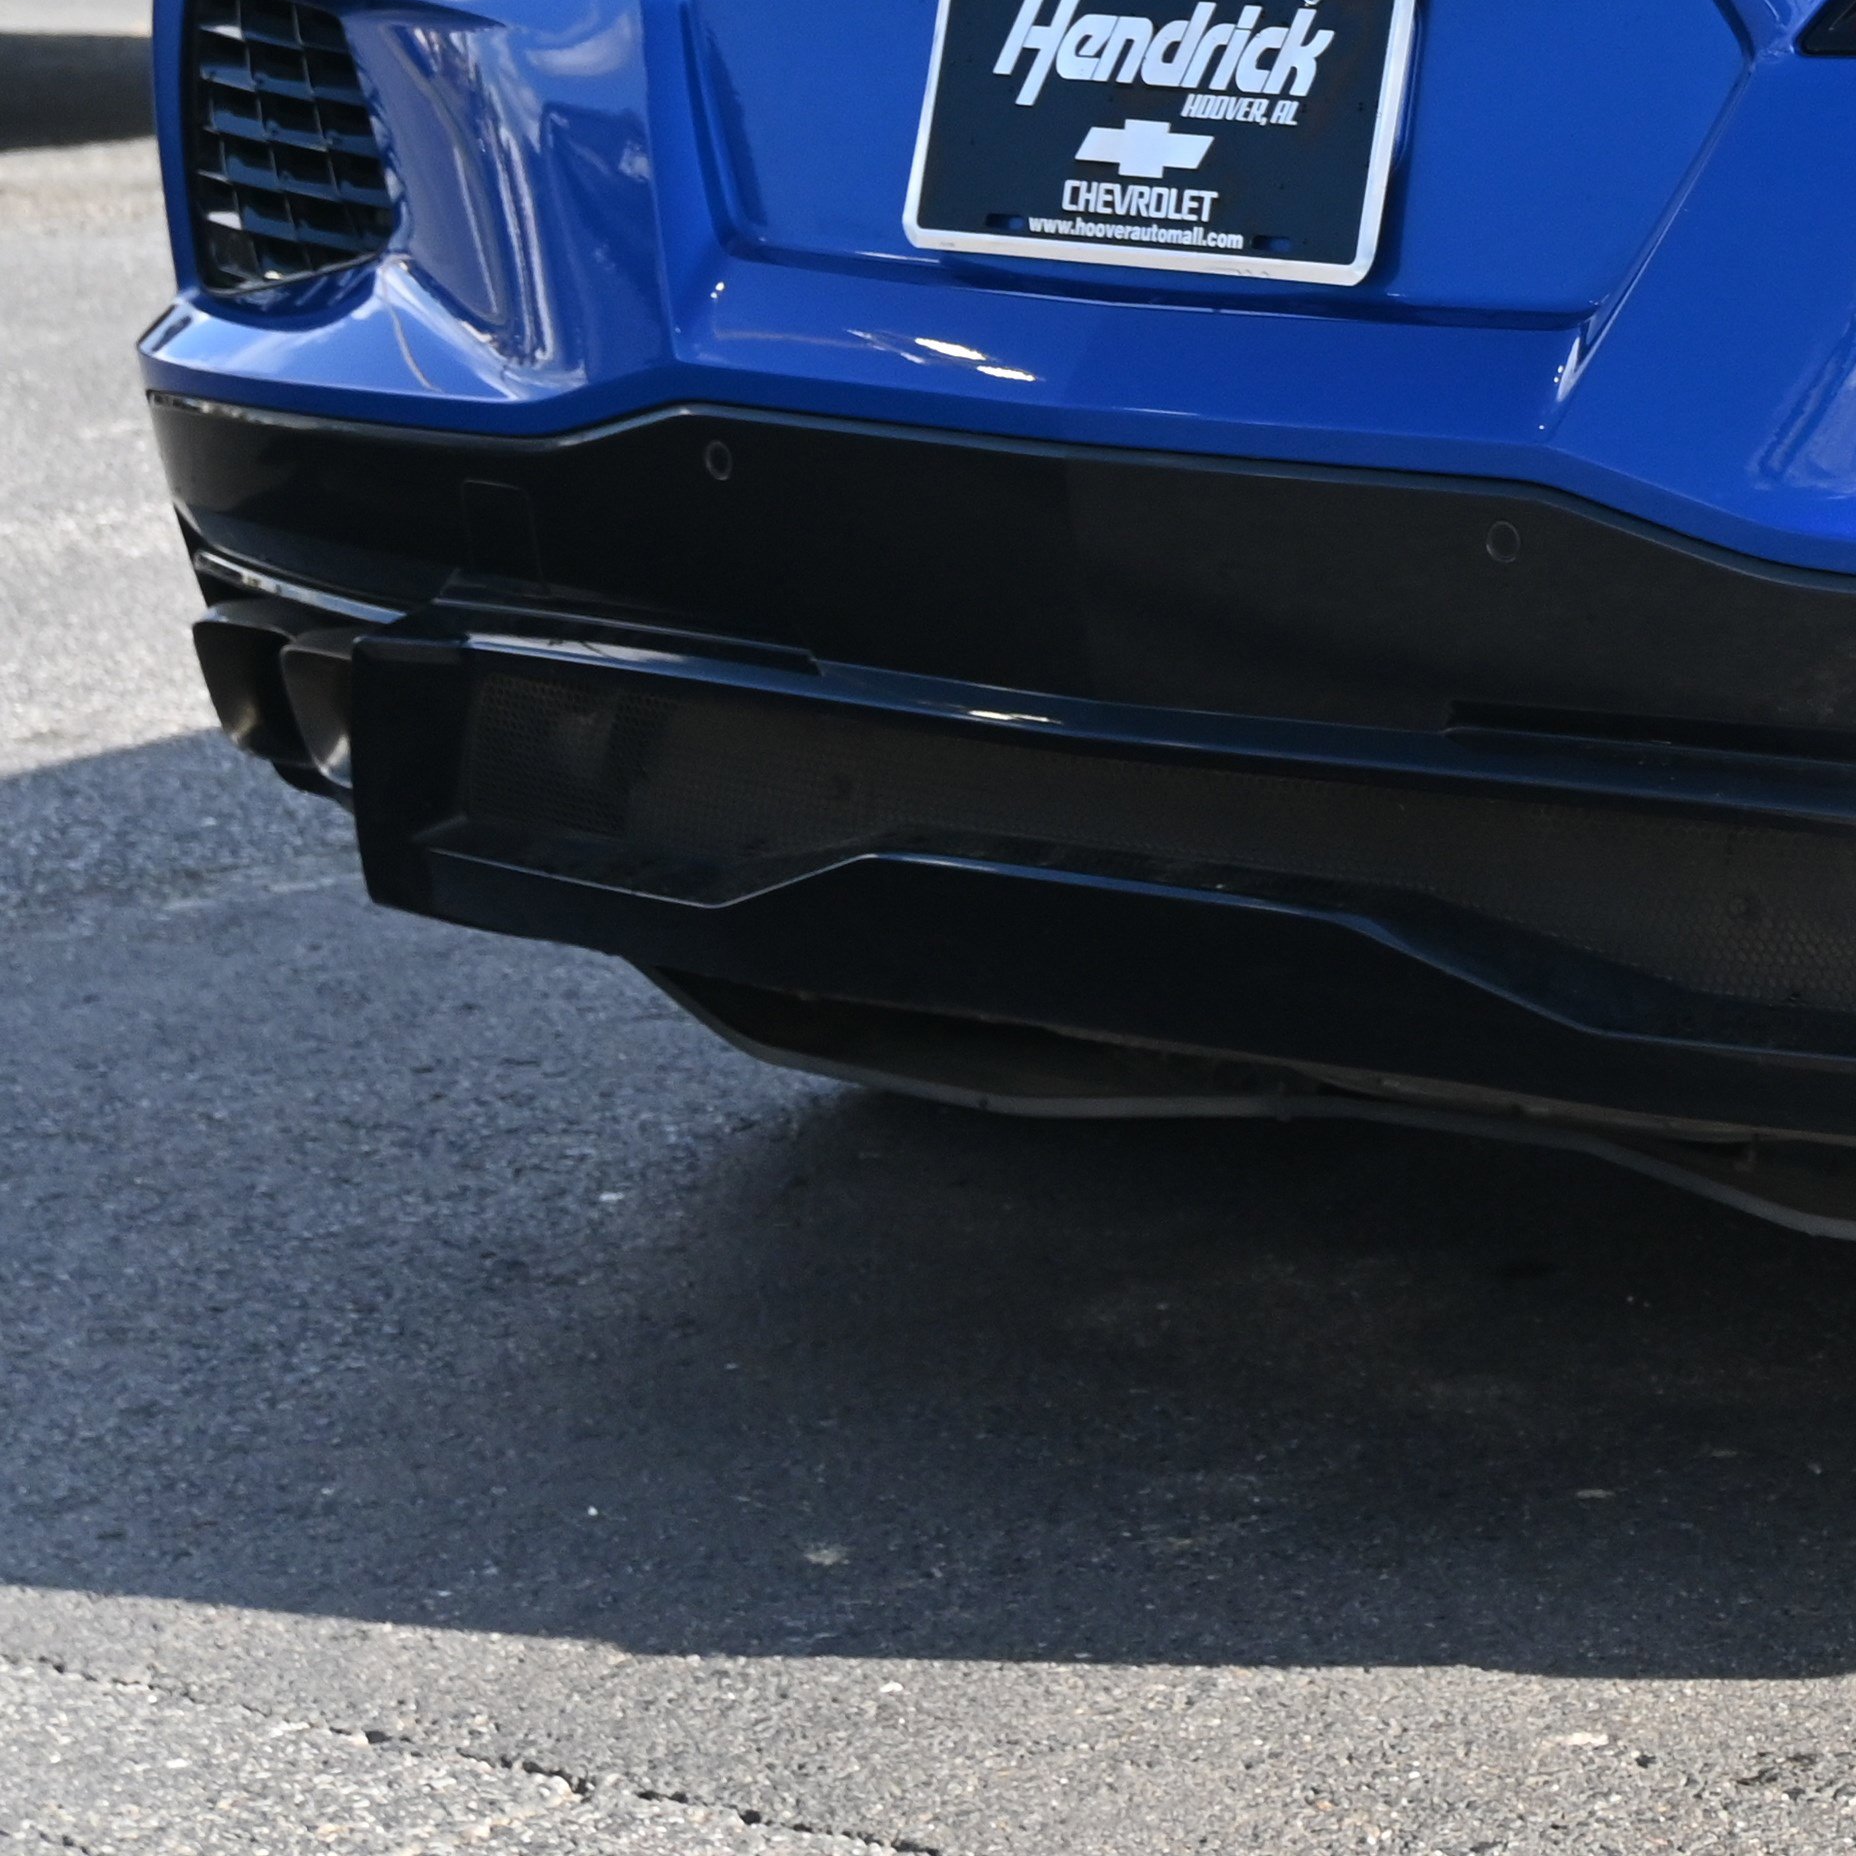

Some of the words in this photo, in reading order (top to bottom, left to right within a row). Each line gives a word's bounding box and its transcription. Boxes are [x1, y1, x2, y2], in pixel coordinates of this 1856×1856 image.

[1180, 94, 1270, 126] HOOVER,
[1270, 101, 1300, 126] AL
[1061, 179, 1219, 223] CHEVROLET
[1028, 216, 1245, 250] www.hooverautomall.com
